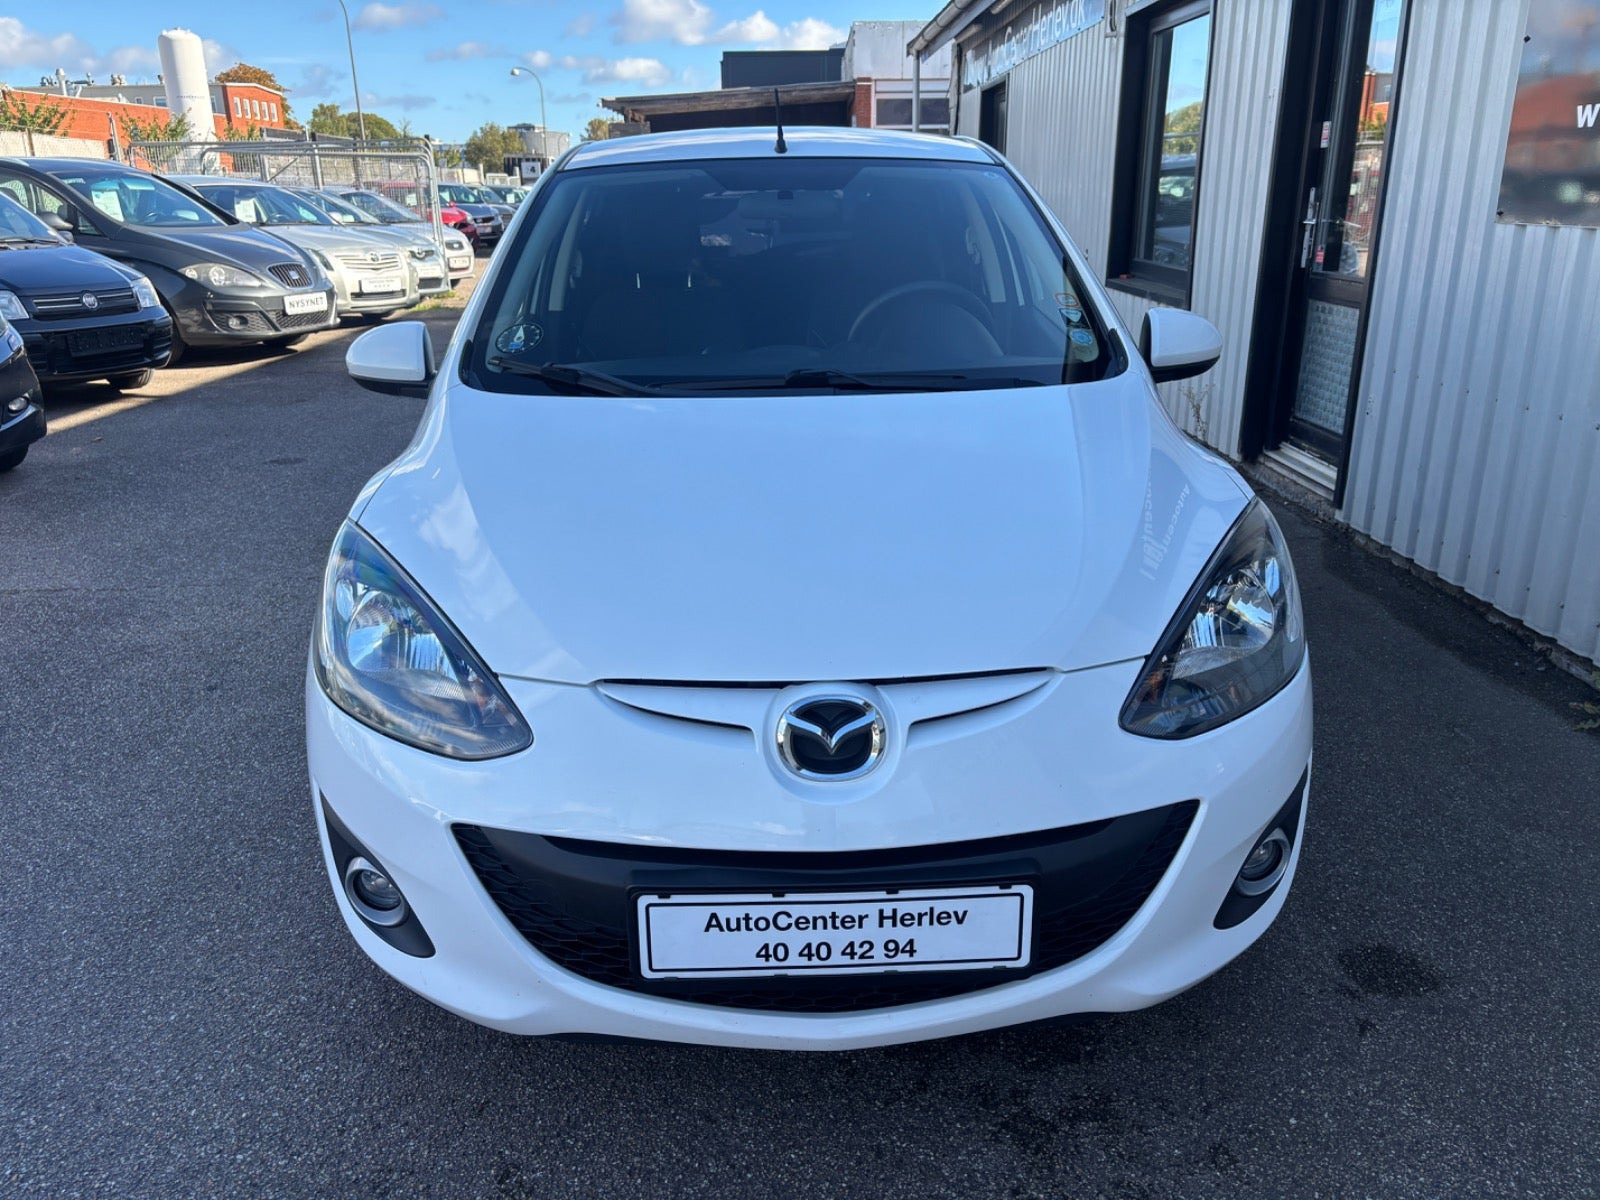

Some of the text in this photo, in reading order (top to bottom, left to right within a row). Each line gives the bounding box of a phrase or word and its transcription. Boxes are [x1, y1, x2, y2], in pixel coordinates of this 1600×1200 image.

[288, 296, 324, 309] NYSYNET
[704, 906, 968, 933] AutoCenter Herlev
[756, 938, 917, 962] 40 40 42 94
